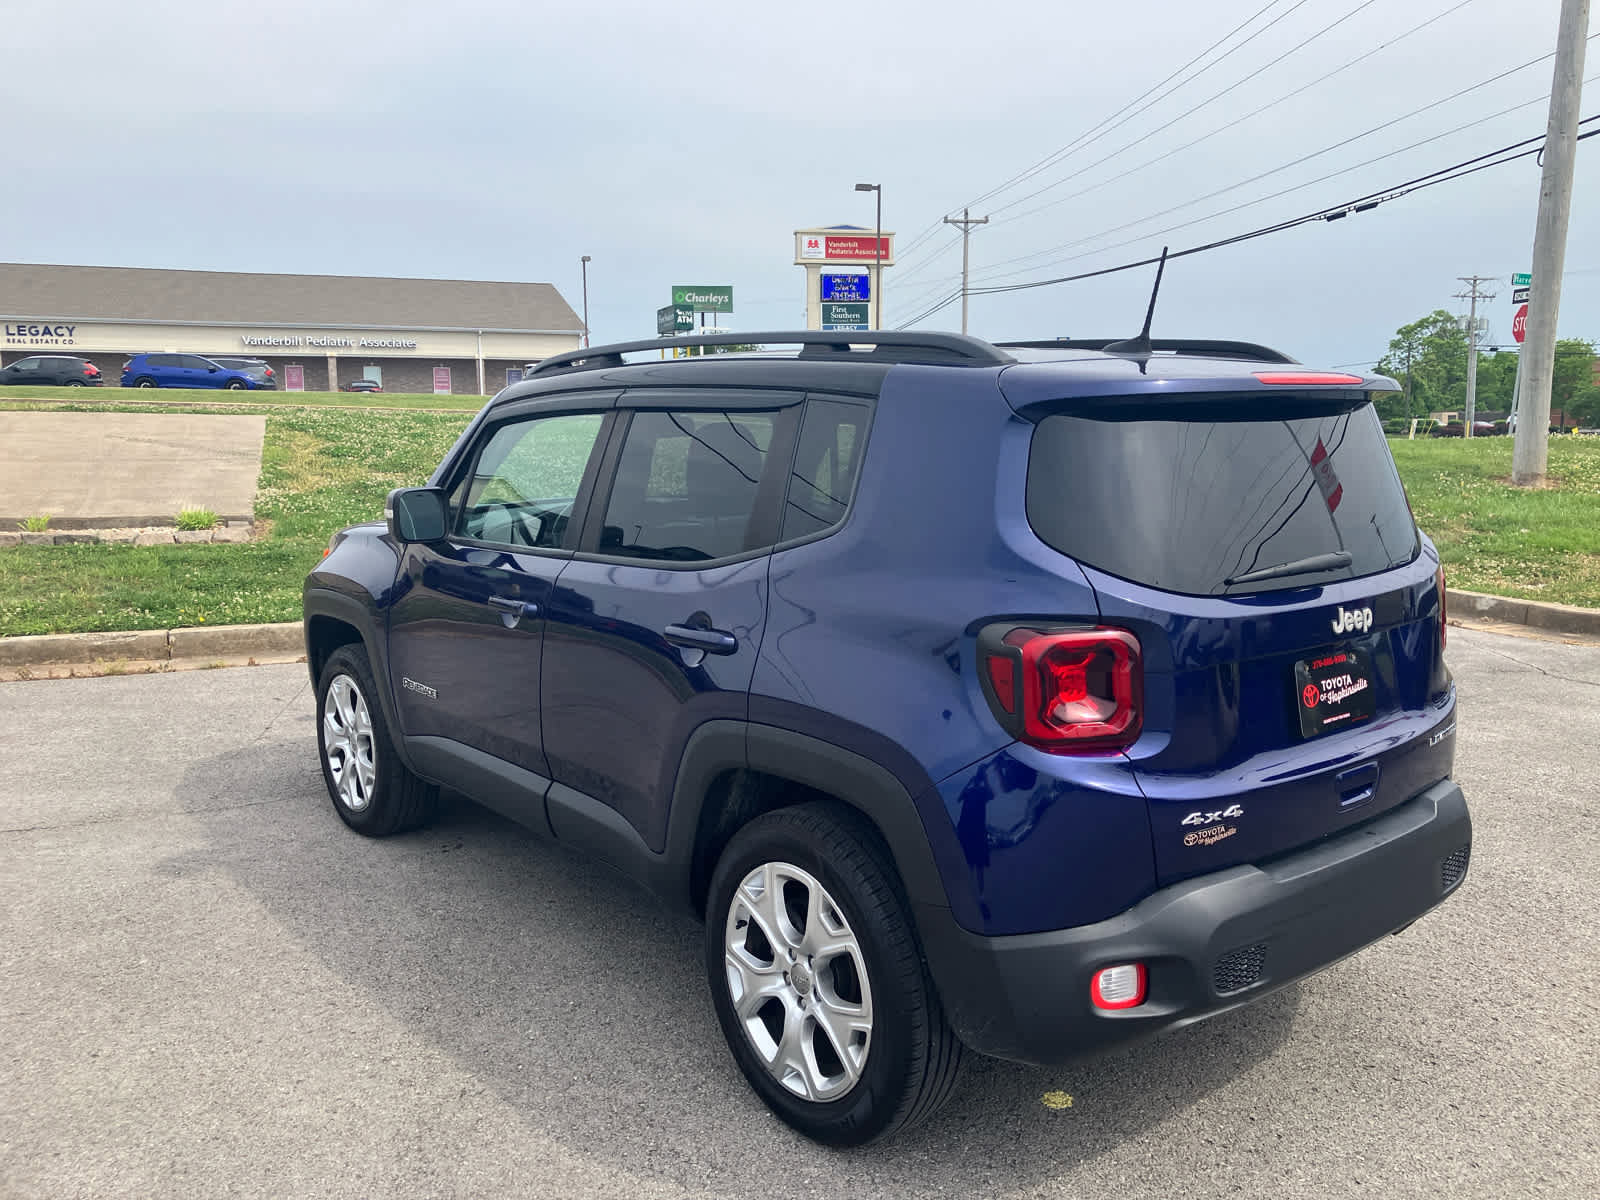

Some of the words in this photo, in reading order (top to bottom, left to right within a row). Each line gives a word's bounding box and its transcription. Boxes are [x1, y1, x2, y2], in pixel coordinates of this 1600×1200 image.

[684, 292, 729, 304] Charleys
[1514, 316, 1527, 331] STO
[5, 325, 76, 337] LEGACY
[242, 335, 304, 346] Vanderbilt
[305, 336, 355, 347] Pediatric
[359, 337, 417, 348] Associates
[1332, 606, 1374, 634] Jeep
[1320, 674, 1353, 691] TOYOTA
[1181, 804, 1244, 825] 4x4
[1198, 825, 1226, 839] TOYOTA
